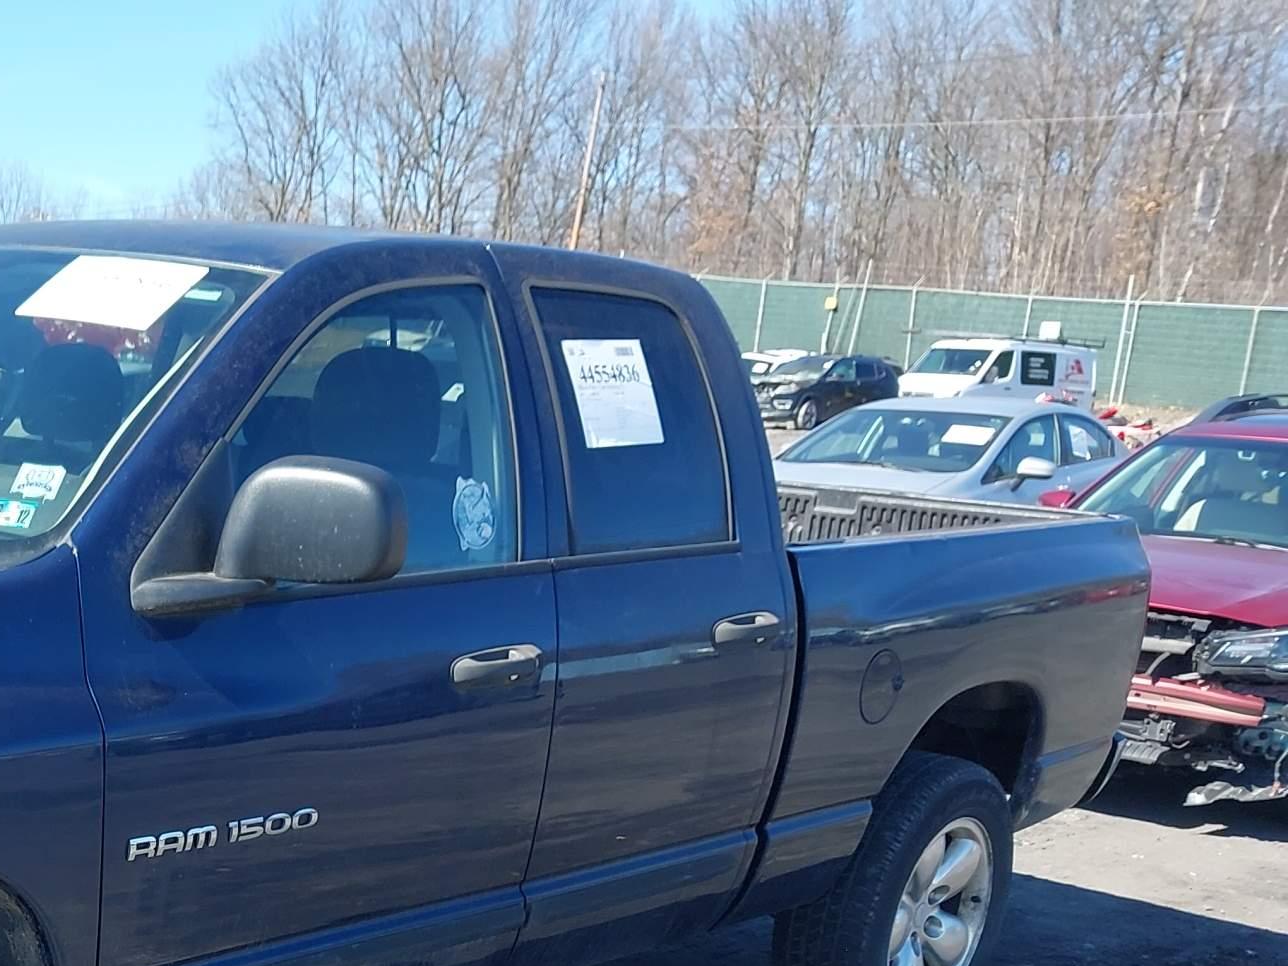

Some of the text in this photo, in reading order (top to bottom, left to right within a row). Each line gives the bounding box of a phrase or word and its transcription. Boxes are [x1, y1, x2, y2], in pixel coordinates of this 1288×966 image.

[579, 364, 640, 383] 44554836
[16, 509, 31, 524] 12
[127, 807, 319, 862] RAM 1500
